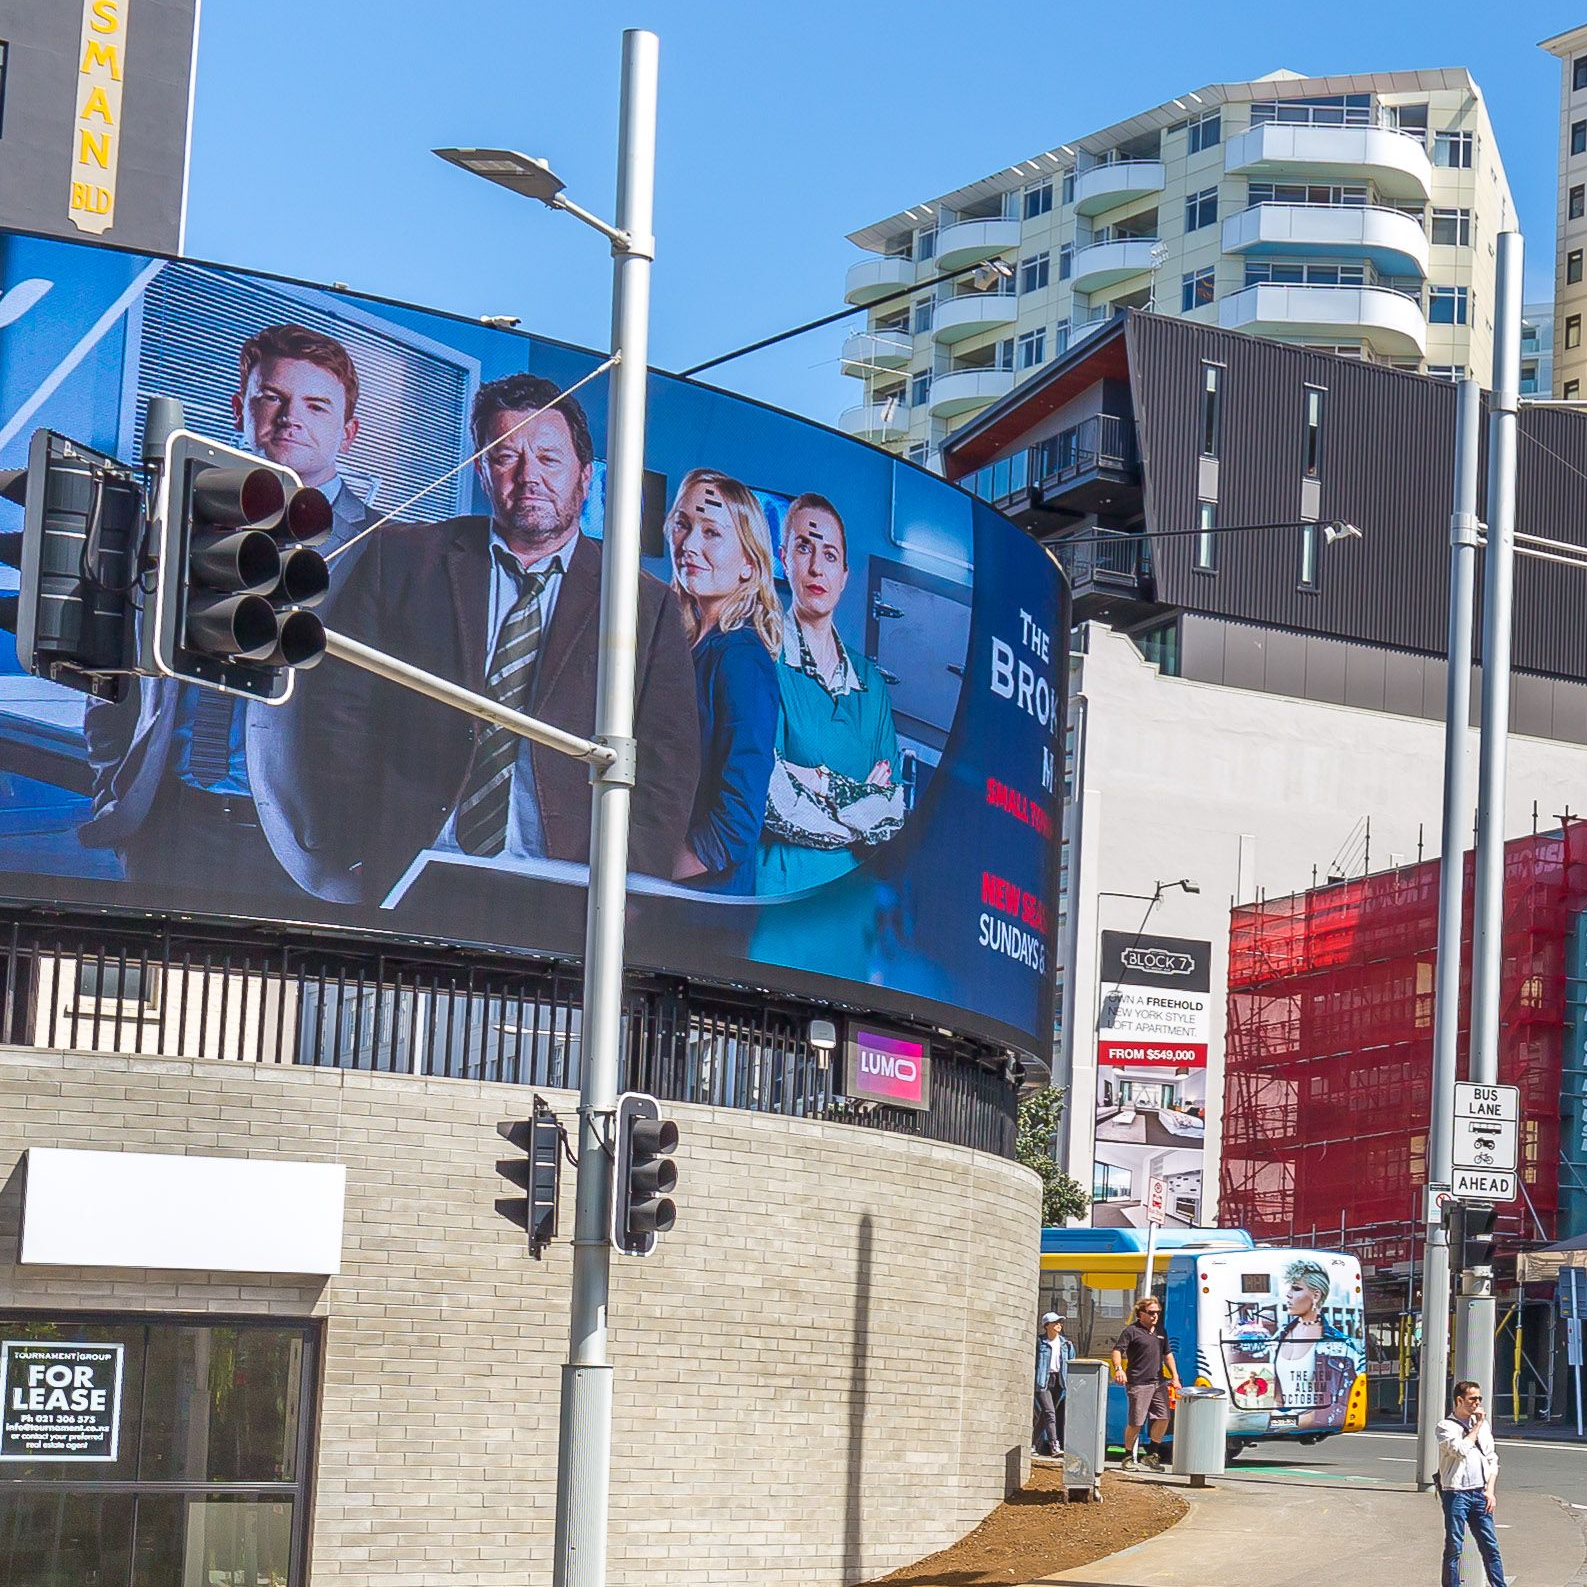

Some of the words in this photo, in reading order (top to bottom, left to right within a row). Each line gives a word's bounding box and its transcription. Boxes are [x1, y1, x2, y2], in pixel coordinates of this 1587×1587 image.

[72, 182, 113, 215] BLD
[1020, 607, 1050, 664] THE
[986, 777, 1028, 824] SMALL
[981, 870, 1021, 917] NEW
[979, 912, 1039, 971] SUNDAYS
[1129, 952, 1175, 969] BLOCK
[1179, 957, 1187, 970] 7
[1146, 997, 1203, 1011] FREEHOLD
[1108, 1006, 1132, 1017] NEW
[1135, 1009, 1163, 1021] YORK
[1165, 1011, 1195, 1024] STYLE
[1107, 1019, 1133, 1030] LOFT
[1108, 1048, 1144, 1060] FROM
[1146, 1049, 1195, 1062] $549,000
[861, 1051, 917, 1082] LUMO
[1473, 1088, 1498, 1102] BUS
[1469, 1103, 1501, 1116] LANE
[1459, 1176, 1509, 1192] AHEAD
[28, 1364, 95, 1388] FOR
[1291, 1370, 1308, 1381] THE
[1295, 1382, 1327, 1392] ALBUM
[12, 1387, 107, 1412] LEASE
[1282, 1394, 1325, 1405] OCTOBER
[20, 1414, 34, 1423] Ph
[35, 1415, 54, 1423] 021
